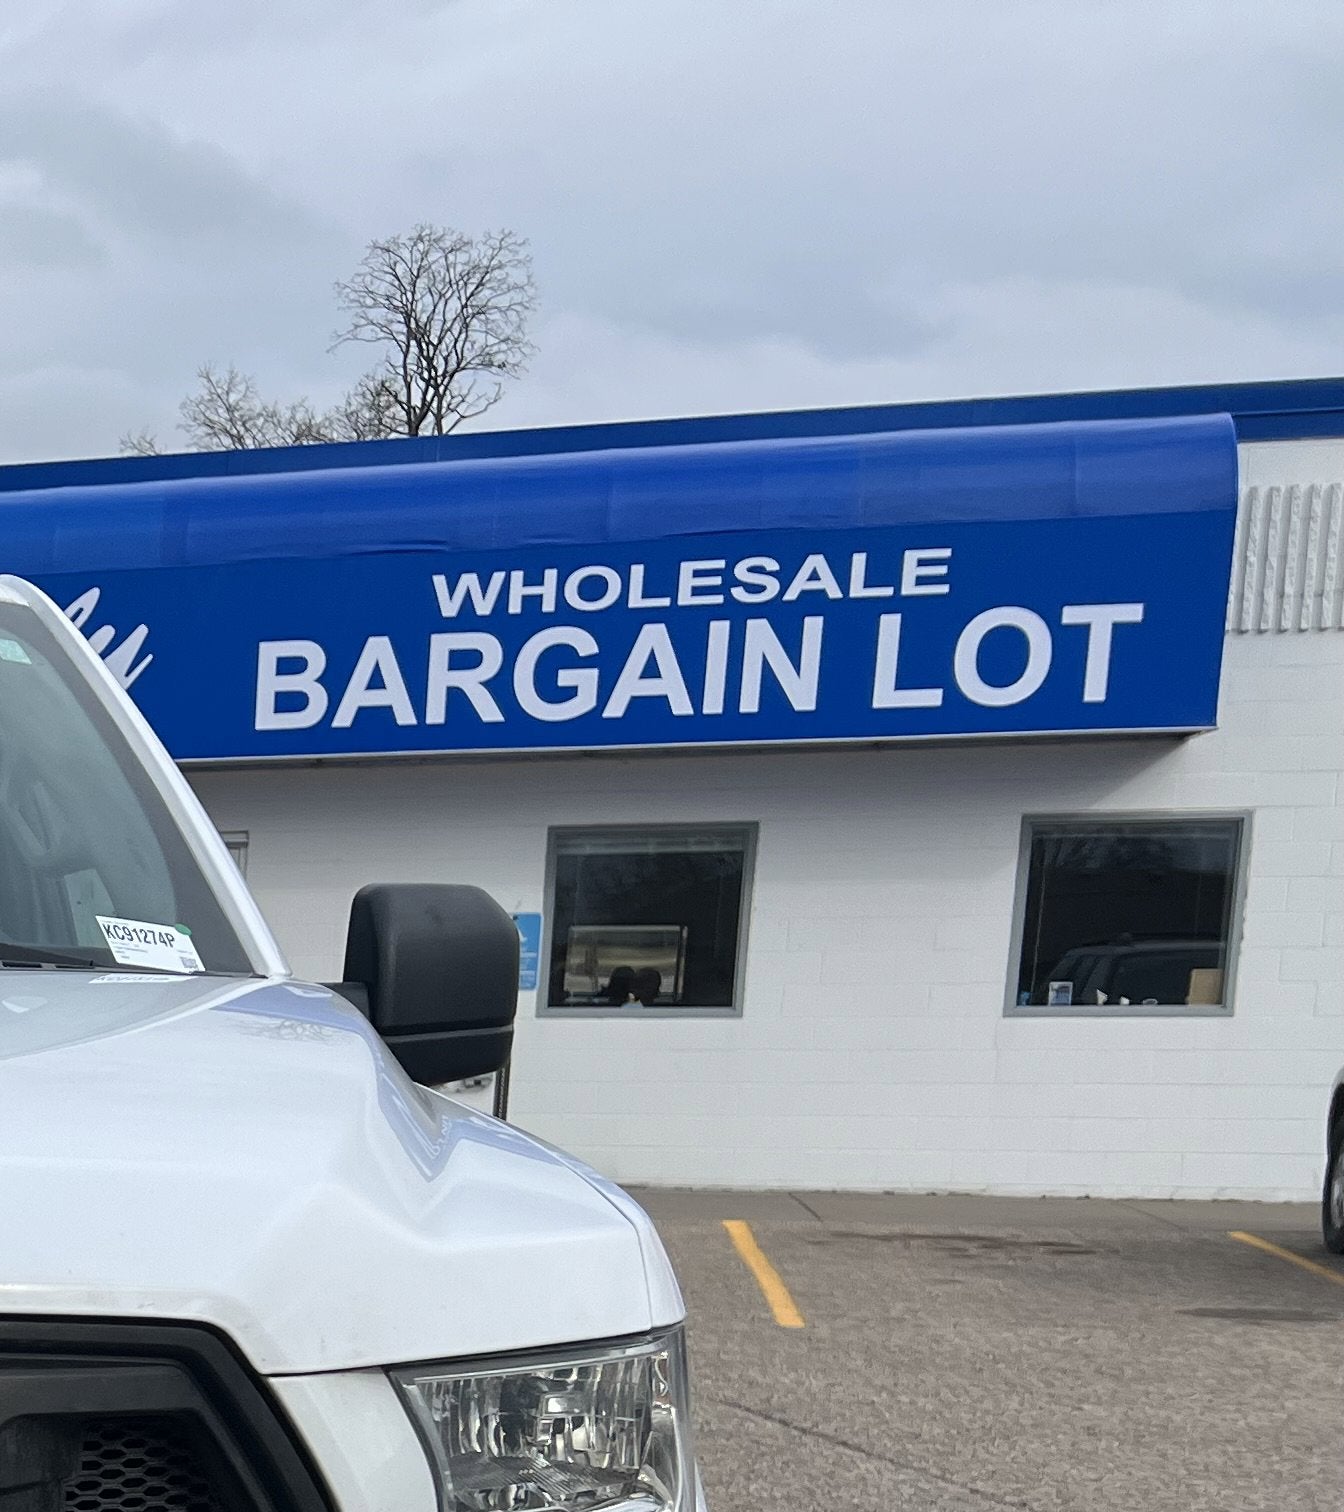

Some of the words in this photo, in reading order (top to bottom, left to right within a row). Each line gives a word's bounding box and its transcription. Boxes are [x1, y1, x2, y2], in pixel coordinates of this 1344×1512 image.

[431, 547, 953, 618] WHOLESALE
[254, 614, 825, 732] BARGAIN
[871, 602, 1144, 709] LOT
[102, 924, 175, 948] KC91274P
